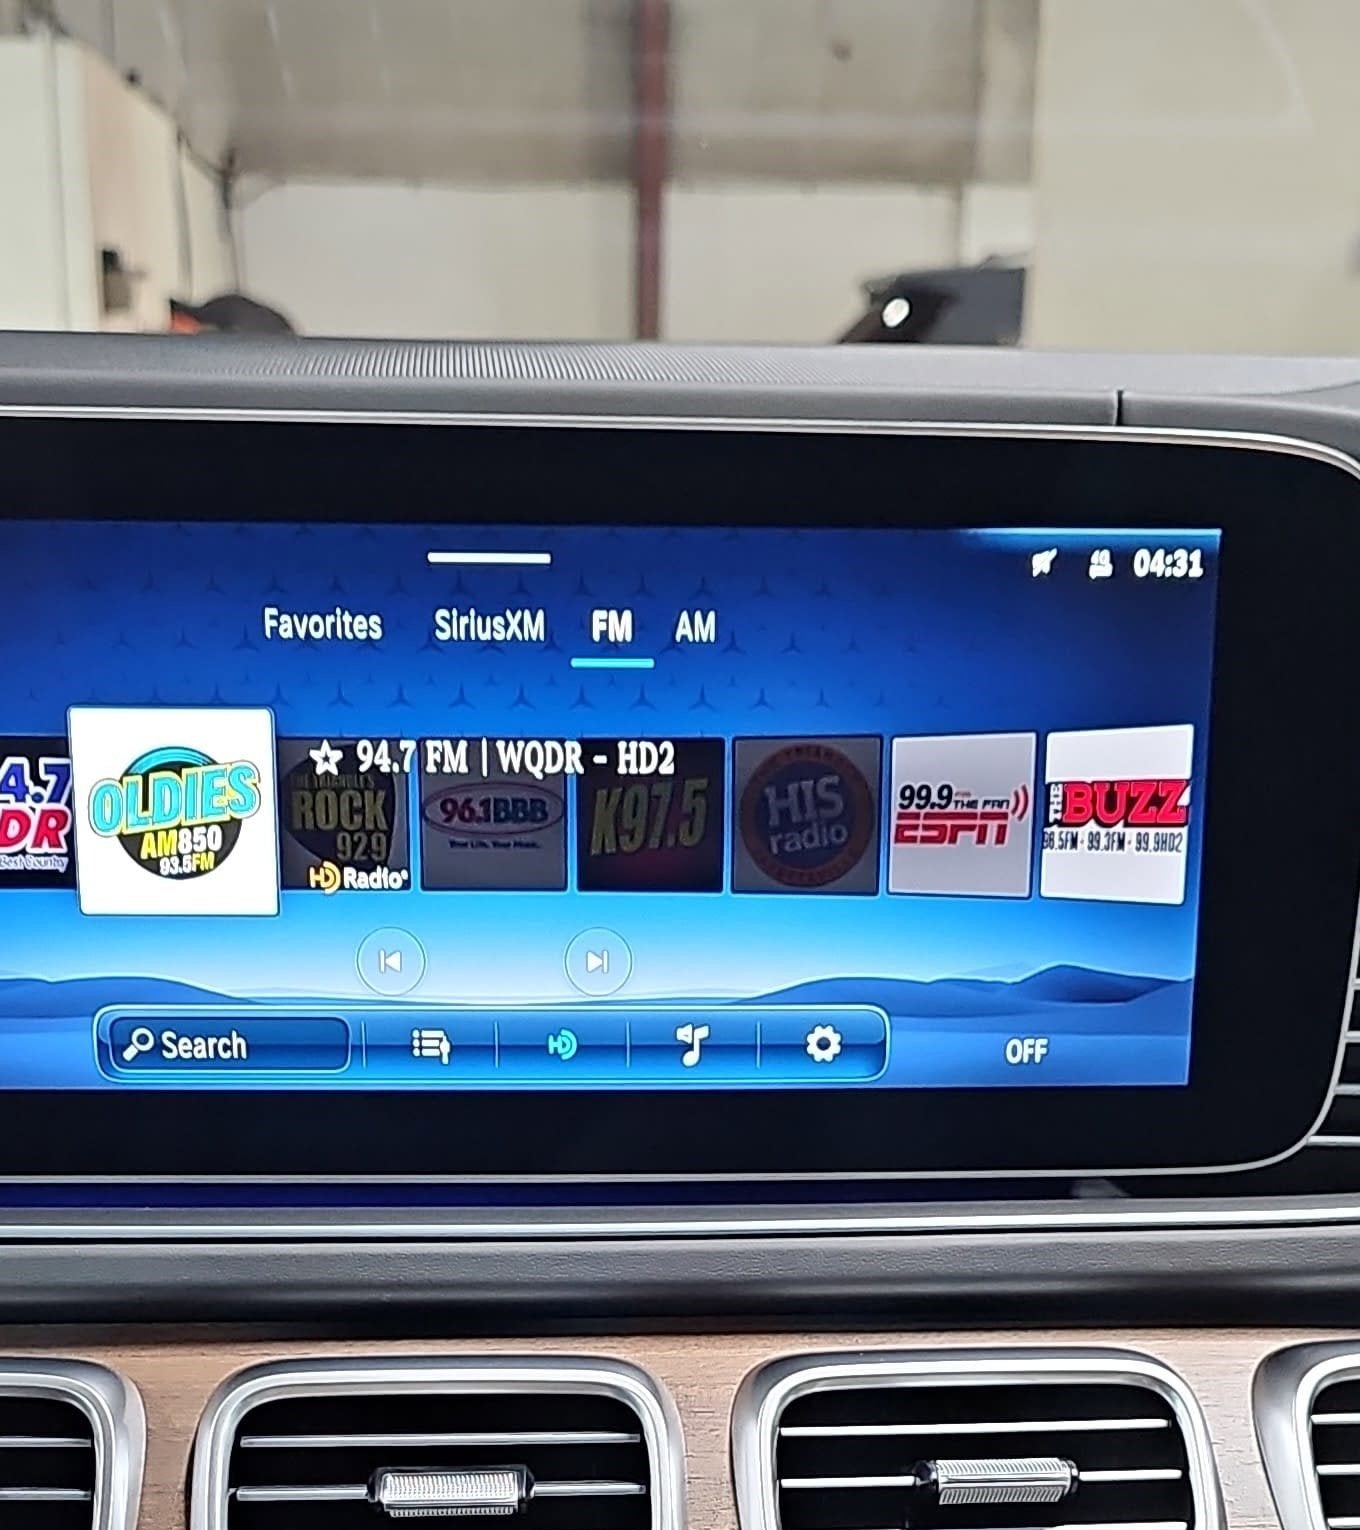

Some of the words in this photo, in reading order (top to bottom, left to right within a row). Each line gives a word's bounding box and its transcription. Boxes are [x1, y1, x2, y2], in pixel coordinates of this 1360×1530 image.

[1133, 548, 1204, 578] 04:31
[264, 607, 384, 641] Favorites
[434, 608, 545, 643] SiriusXM
[592, 609, 633, 643] FM
[675, 610, 716, 643] AM
[357, 739, 417, 773] 94.7
[425, 740, 469, 773] FM
[496, 739, 584, 780] WQDR
[616, 740, 675, 775] HD2
[88, 760, 262, 838] OLDIES
[291, 789, 389, 831] ROCK
[764, 775, 844, 827] HIS
[898, 783, 954, 810] 99.9
[1062, 780, 1187, 825] BUZZ
[590, 778, 709, 856] K97.5
[894, 811, 1009, 845] ESPN
[140, 824, 223, 860] AM850
[336, 832, 388, 862] 929
[770, 820, 848, 855] radio
[343, 866, 402, 889] Radio
[161, 1030, 248, 1061] Search
[1005, 1037, 1049, 1066] OFF
